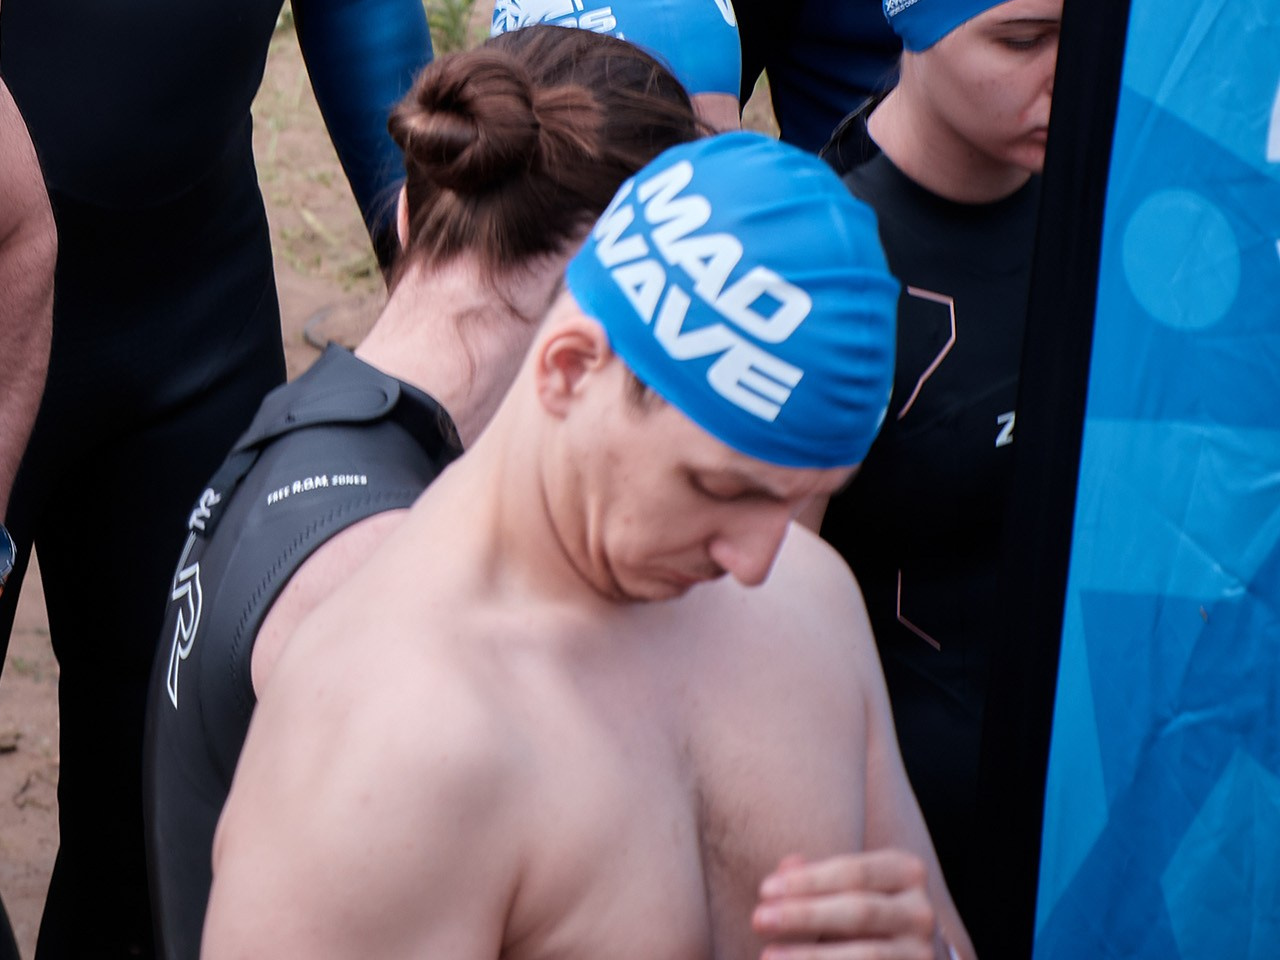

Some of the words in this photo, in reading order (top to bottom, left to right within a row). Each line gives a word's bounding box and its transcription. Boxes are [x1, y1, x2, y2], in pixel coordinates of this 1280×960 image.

[592, 178, 805, 423] WAVE
[636, 160, 813, 344] MAD
[188, 487, 221, 531] TYR
